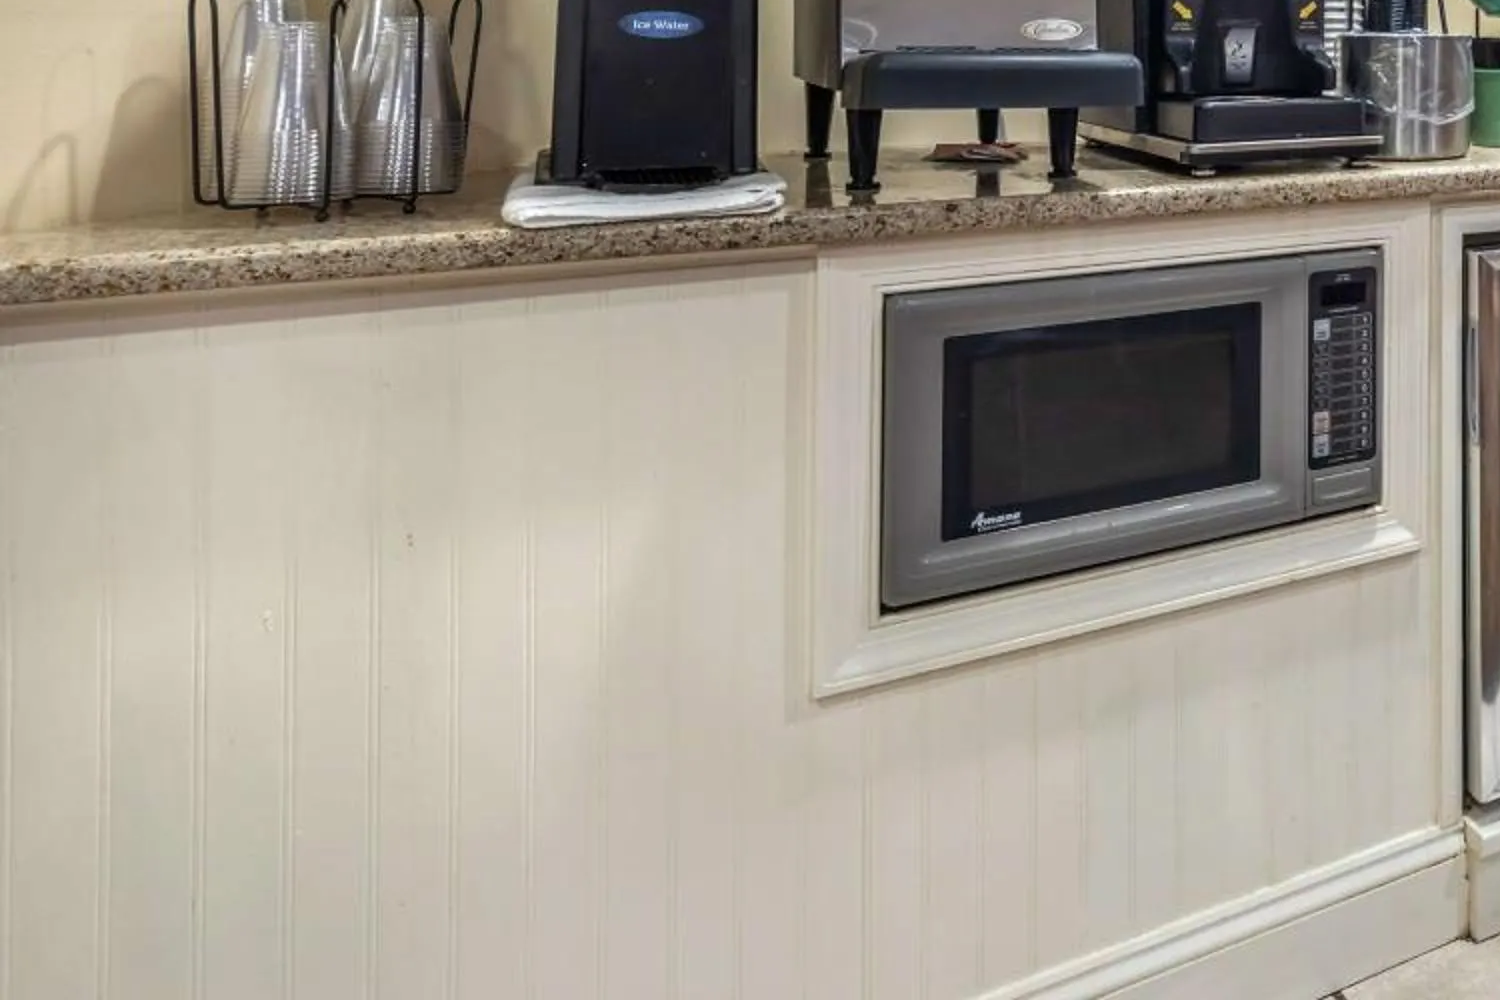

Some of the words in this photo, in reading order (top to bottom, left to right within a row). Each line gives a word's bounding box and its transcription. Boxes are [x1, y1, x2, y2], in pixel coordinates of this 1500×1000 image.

[633, 19, 651, 30] Ice
[653, 18, 690, 31] Water
[971, 511, 1021, 529] Amana
